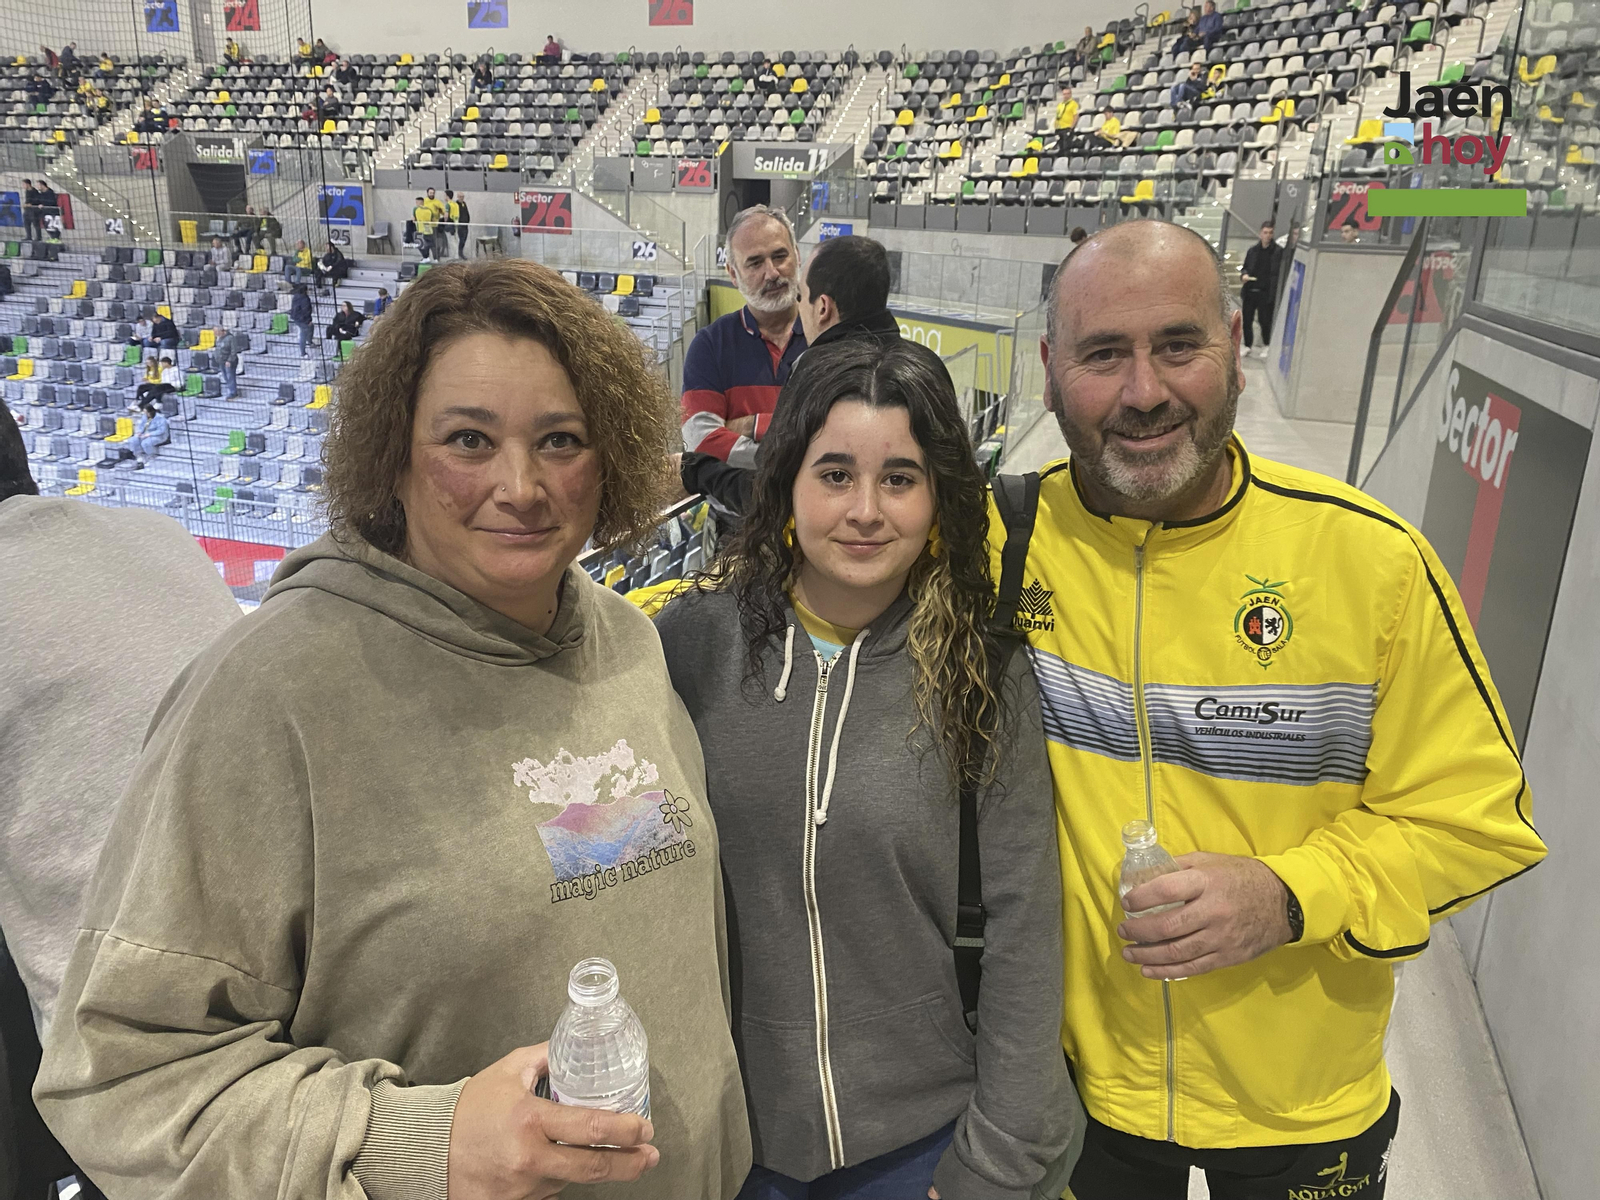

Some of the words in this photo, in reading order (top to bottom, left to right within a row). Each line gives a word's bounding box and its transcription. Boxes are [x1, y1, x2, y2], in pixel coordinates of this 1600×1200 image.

[224, 0, 261, 31] 24
[468, 0, 508, 28] 25
[648, 0, 693, 26] 26
[196, 144, 233, 158] Salida
[754, 156, 804, 171] Salida
[808, 149, 829, 172] 11
[678, 160, 712, 187] 26
[317, 185, 346, 196] Sector
[520, 192, 553, 203] Sector
[1333, 182, 1370, 194] Sector
[318, 185, 364, 226] 25
[521, 191, 572, 235] 26
[820, 224, 841, 237] Sector
[633, 241, 657, 261] 26
[1438, 367, 1519, 489] Sector
[1249, 596, 1280, 606] JAEN
[1235, 634, 1256, 654] FUTBOL
[1272, 640, 1287, 654] SALA
[1195, 697, 1307, 725] CamiSur
[1194, 726, 1244, 738] VEHÍCULOS
[1246, 731, 1307, 742] INDUSTRIALES
[551, 864, 617, 904] magic
[621, 839, 697, 882] nature
